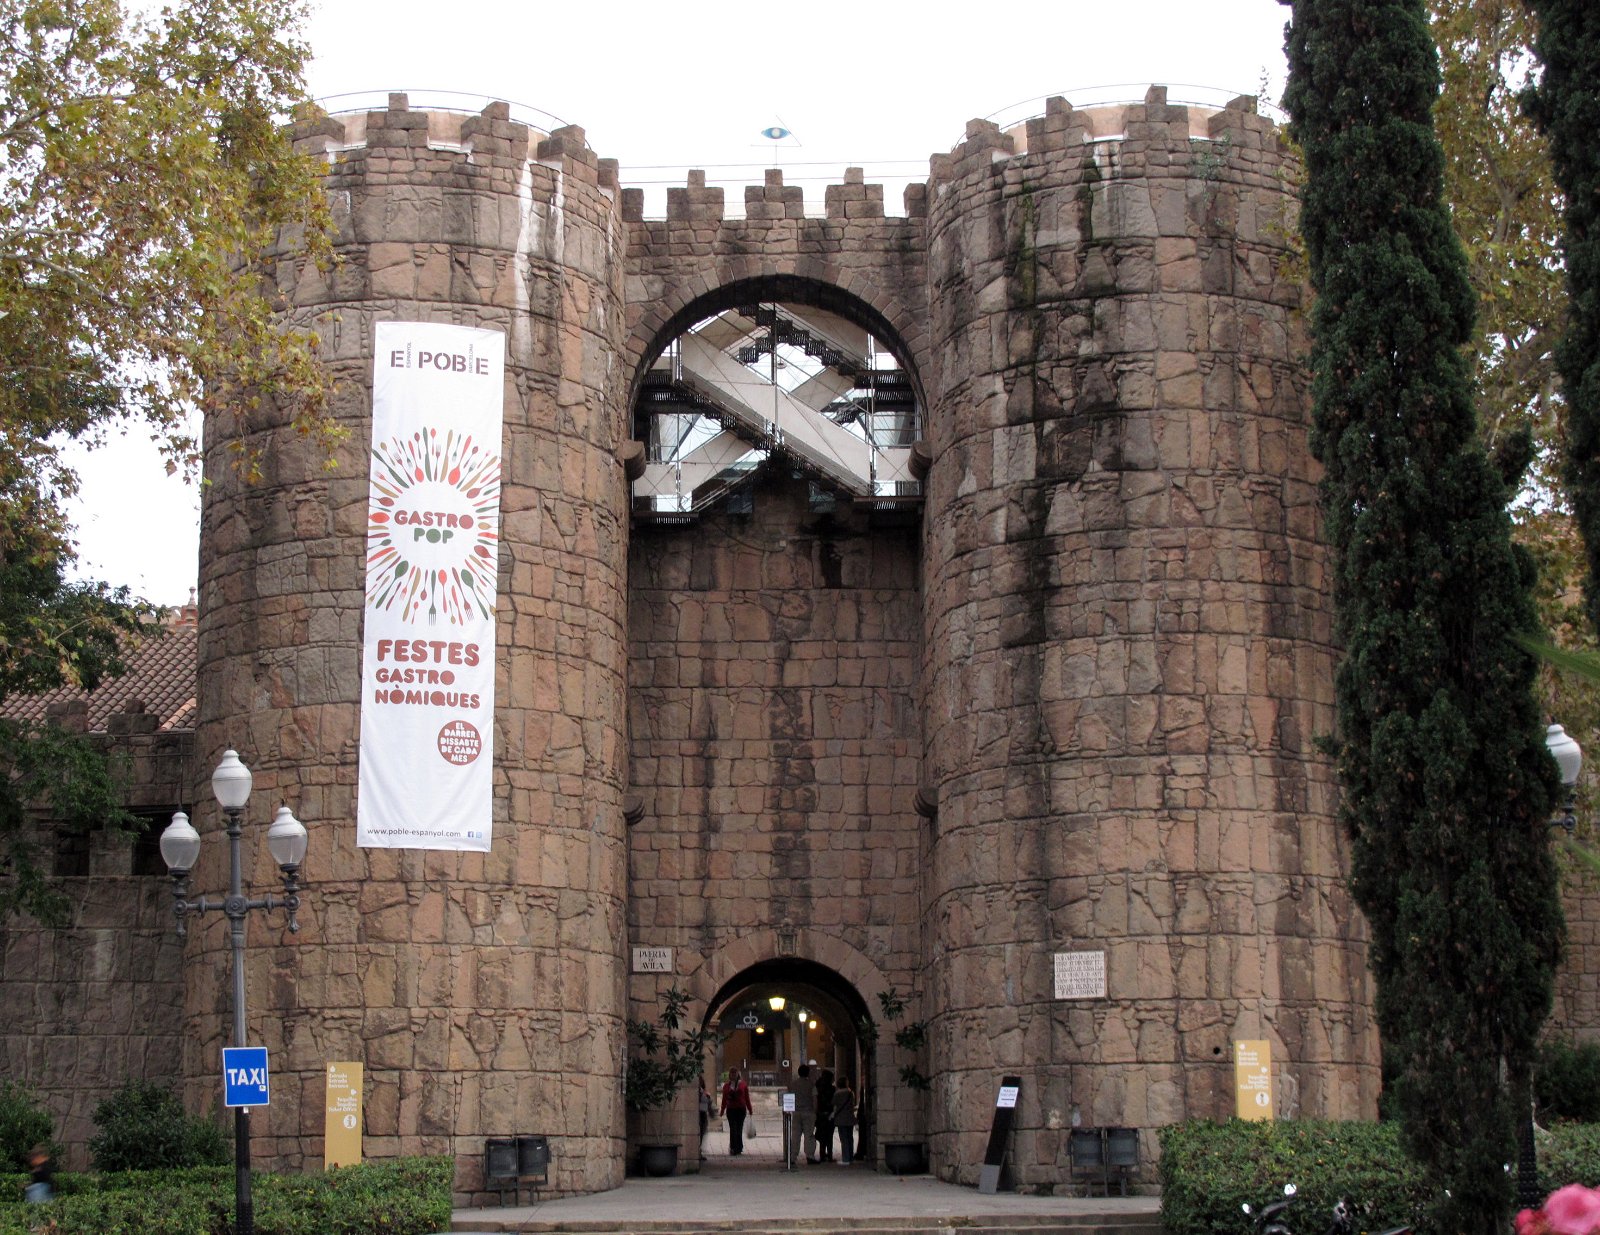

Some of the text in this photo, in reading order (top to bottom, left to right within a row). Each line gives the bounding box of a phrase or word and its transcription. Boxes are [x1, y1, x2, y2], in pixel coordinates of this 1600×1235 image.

[394, 510, 474, 529] GASTRO
[413, 527, 454, 544] POP
[377, 639, 480, 667] FESTES
[375, 668, 455, 685] GASTRO
[375, 685, 481, 709] NÒMIQUES
[455, 722, 465, 730] EL
[444, 729, 476, 739] DARRER
[440, 737, 480, 748] DISSABTE
[441, 745, 478, 755] DE CADA
[451, 753, 468, 763] MES
[367, 828, 461, 838] www.poble-espanyol.com
[227, 1068, 266, 1086] TAXI
